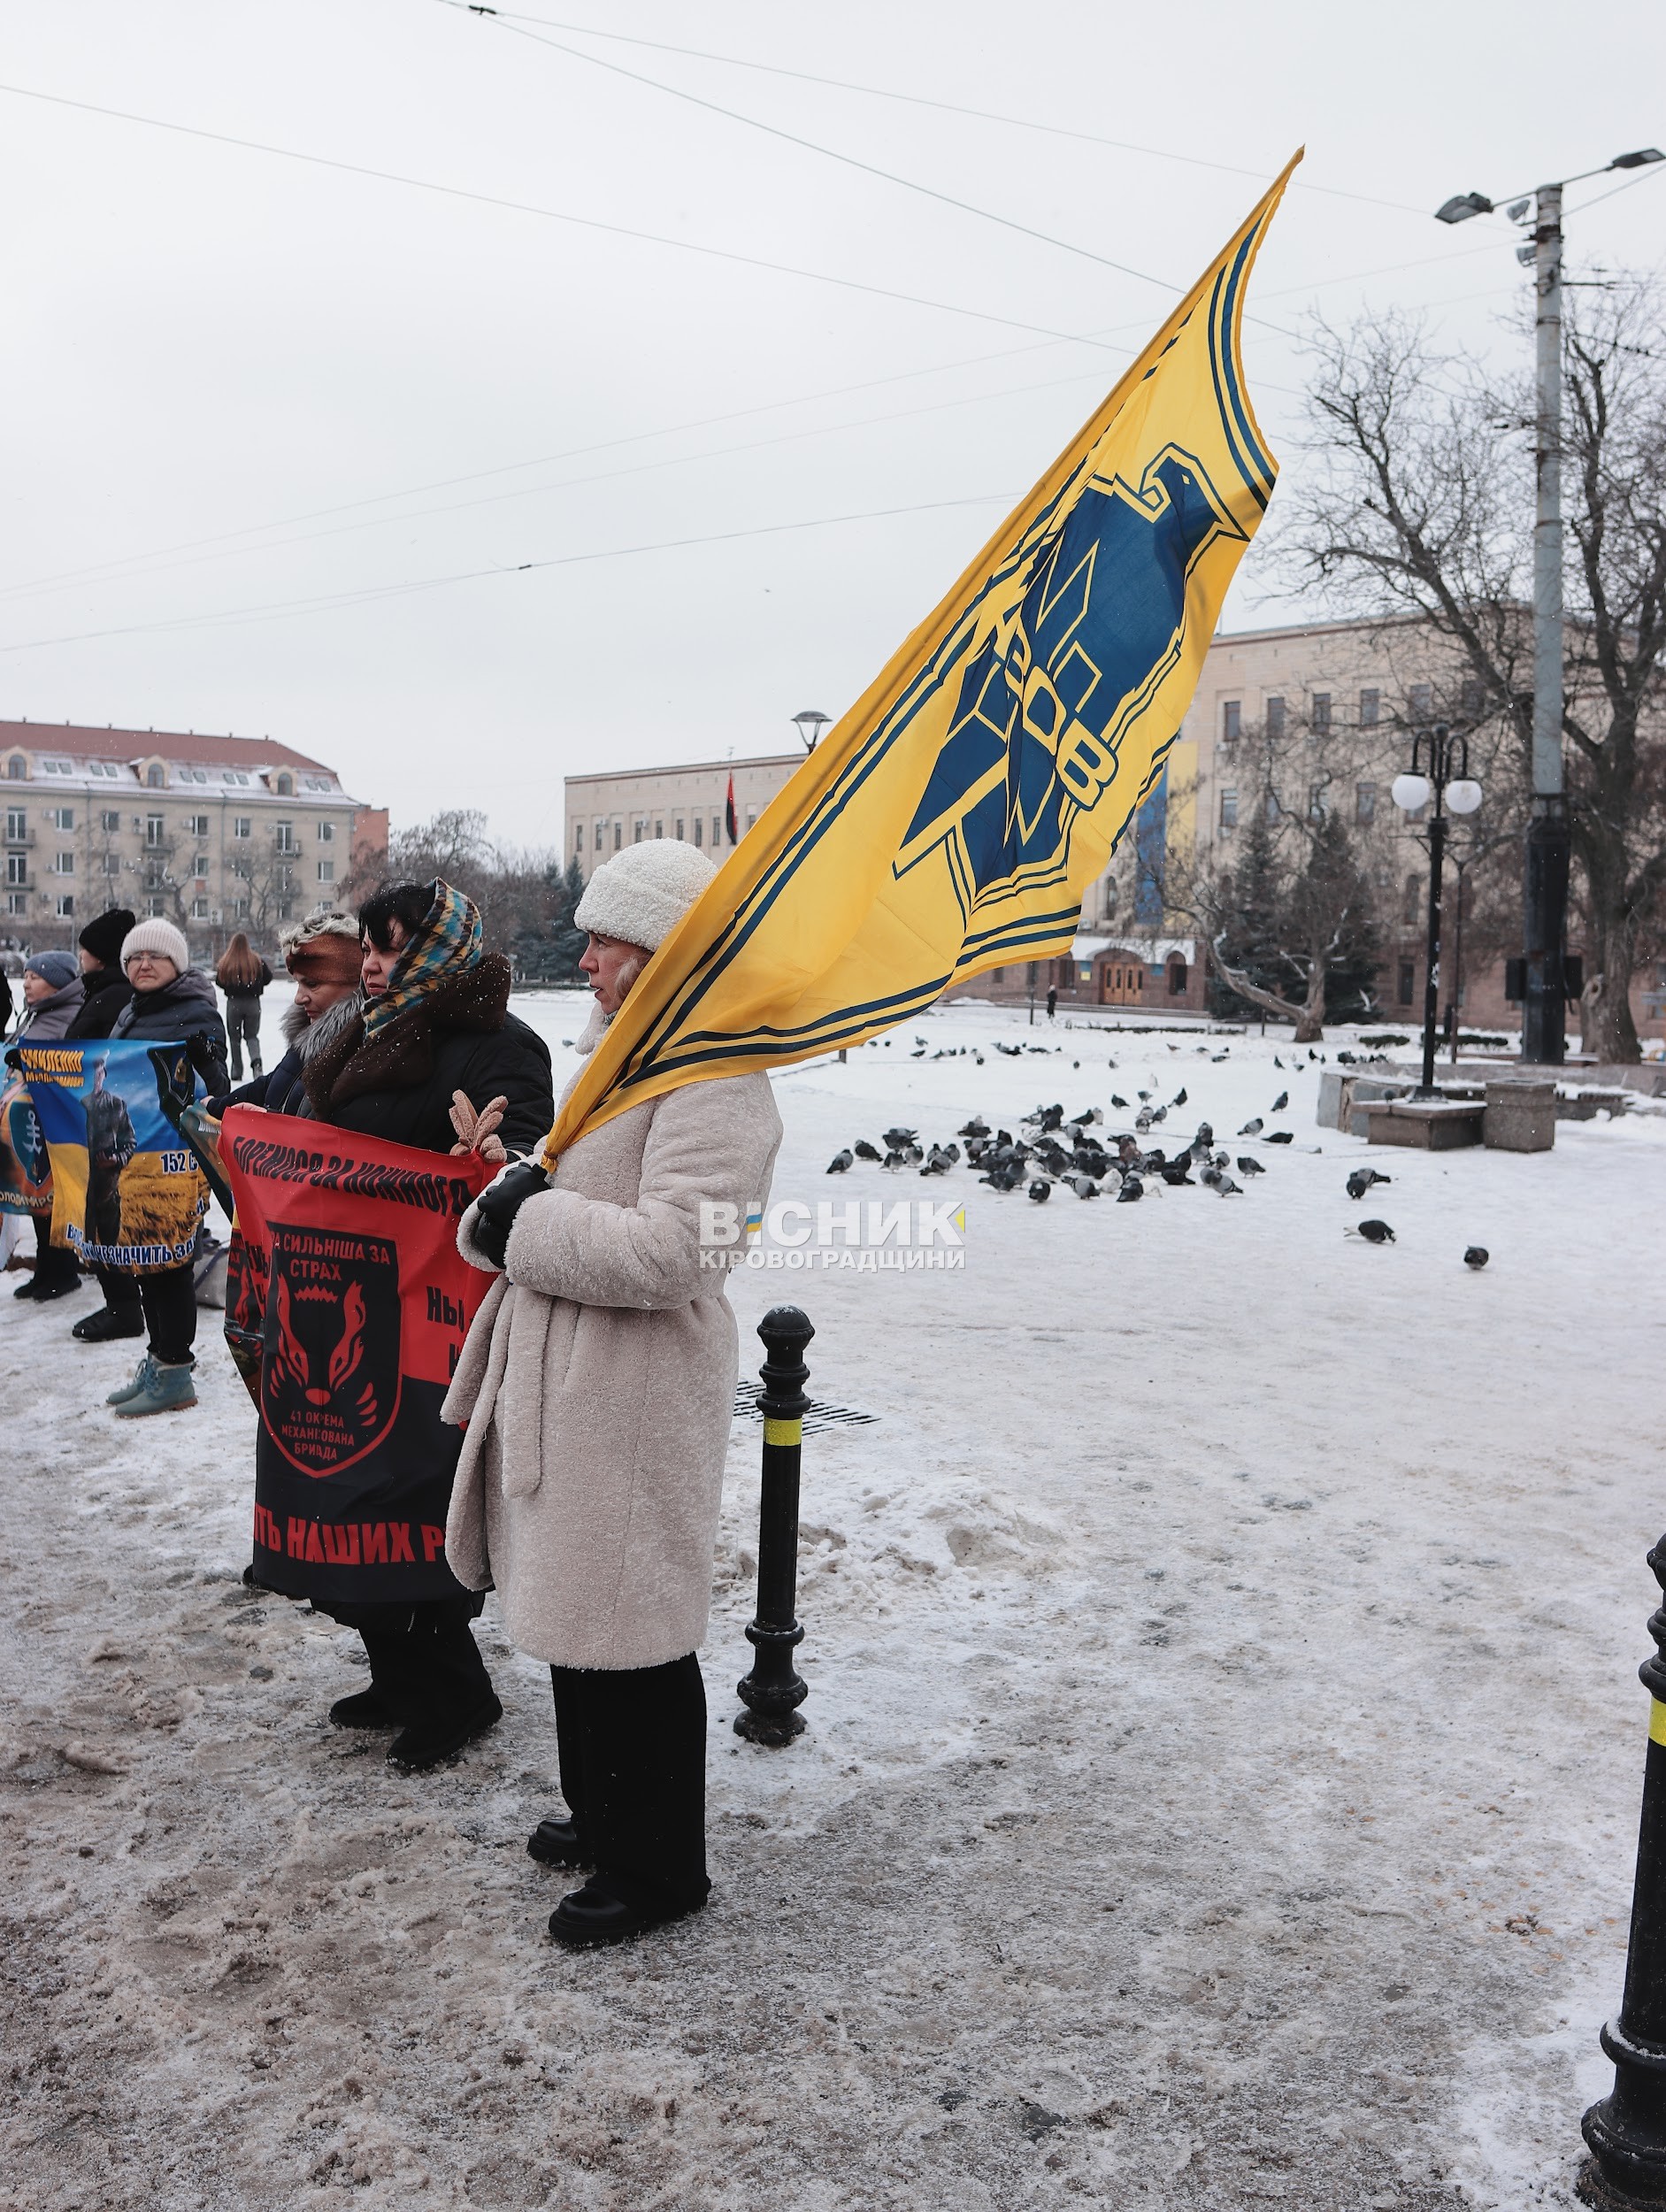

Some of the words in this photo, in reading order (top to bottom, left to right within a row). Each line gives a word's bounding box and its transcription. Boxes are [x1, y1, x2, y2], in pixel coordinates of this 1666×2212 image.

[160, 1151, 187, 1174] 152
[233, 1136, 324, 1187] БОРЕМОСЯ
[321, 1155, 355, 1191] ЗА
[342, 1162, 477, 1217] КОЖНОГО
[108, 1244, 173, 1266] ЗНАЧИТЬ
[174, 1233, 196, 1260] ЗА
[283, 1233, 366, 1262] СИЛЬНІША
[369, 1244, 390, 1266] ЗА
[289, 1258, 342, 1282] СТРАХ
[290, 1409, 302, 1423] 41
[305, 1411, 344, 1429] ОКЕМА
[281, 1425, 355, 1447] МЕХАНІОВАНА
[288, 1516, 416, 1565] НАШИХ
